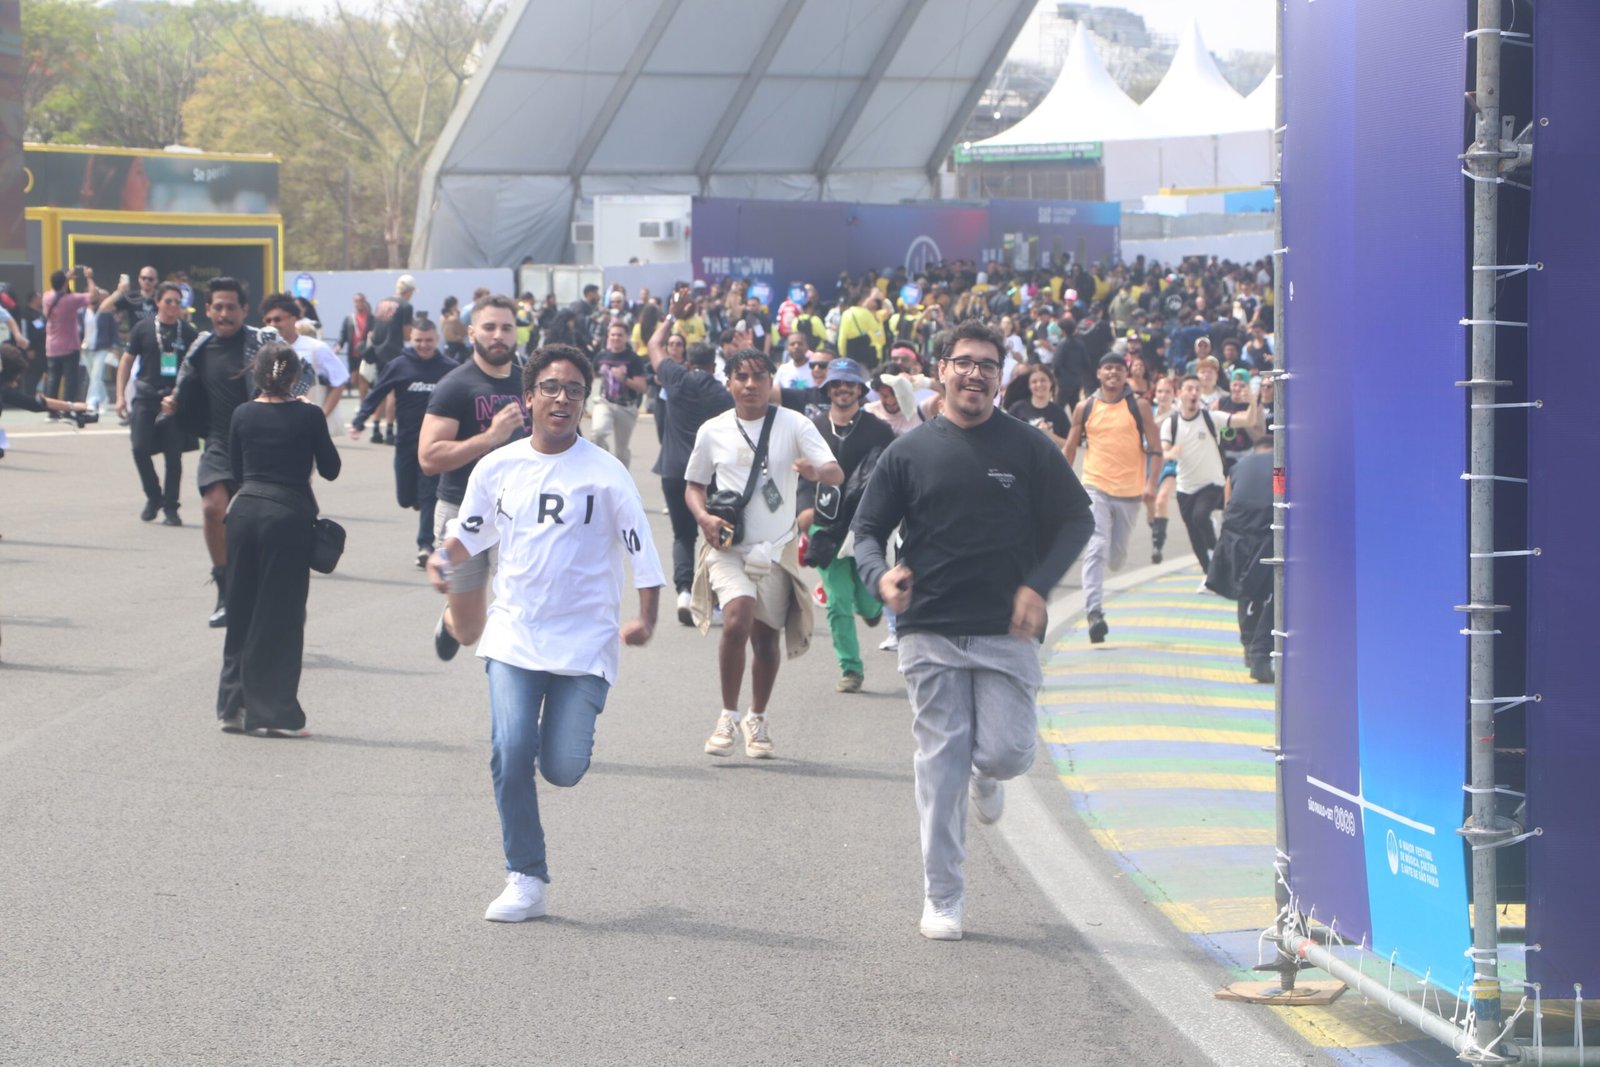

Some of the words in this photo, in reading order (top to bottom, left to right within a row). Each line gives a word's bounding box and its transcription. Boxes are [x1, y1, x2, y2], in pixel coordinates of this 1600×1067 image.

[702, 256, 730, 275] THE
[731, 256, 774, 277] TOWN
[1334, 805, 1355, 836] 2025
[1415, 846, 1433, 862] FESTIVAL
[1420, 860, 1438, 875] CULTURA
[1426, 874, 1439, 889] PAULO
